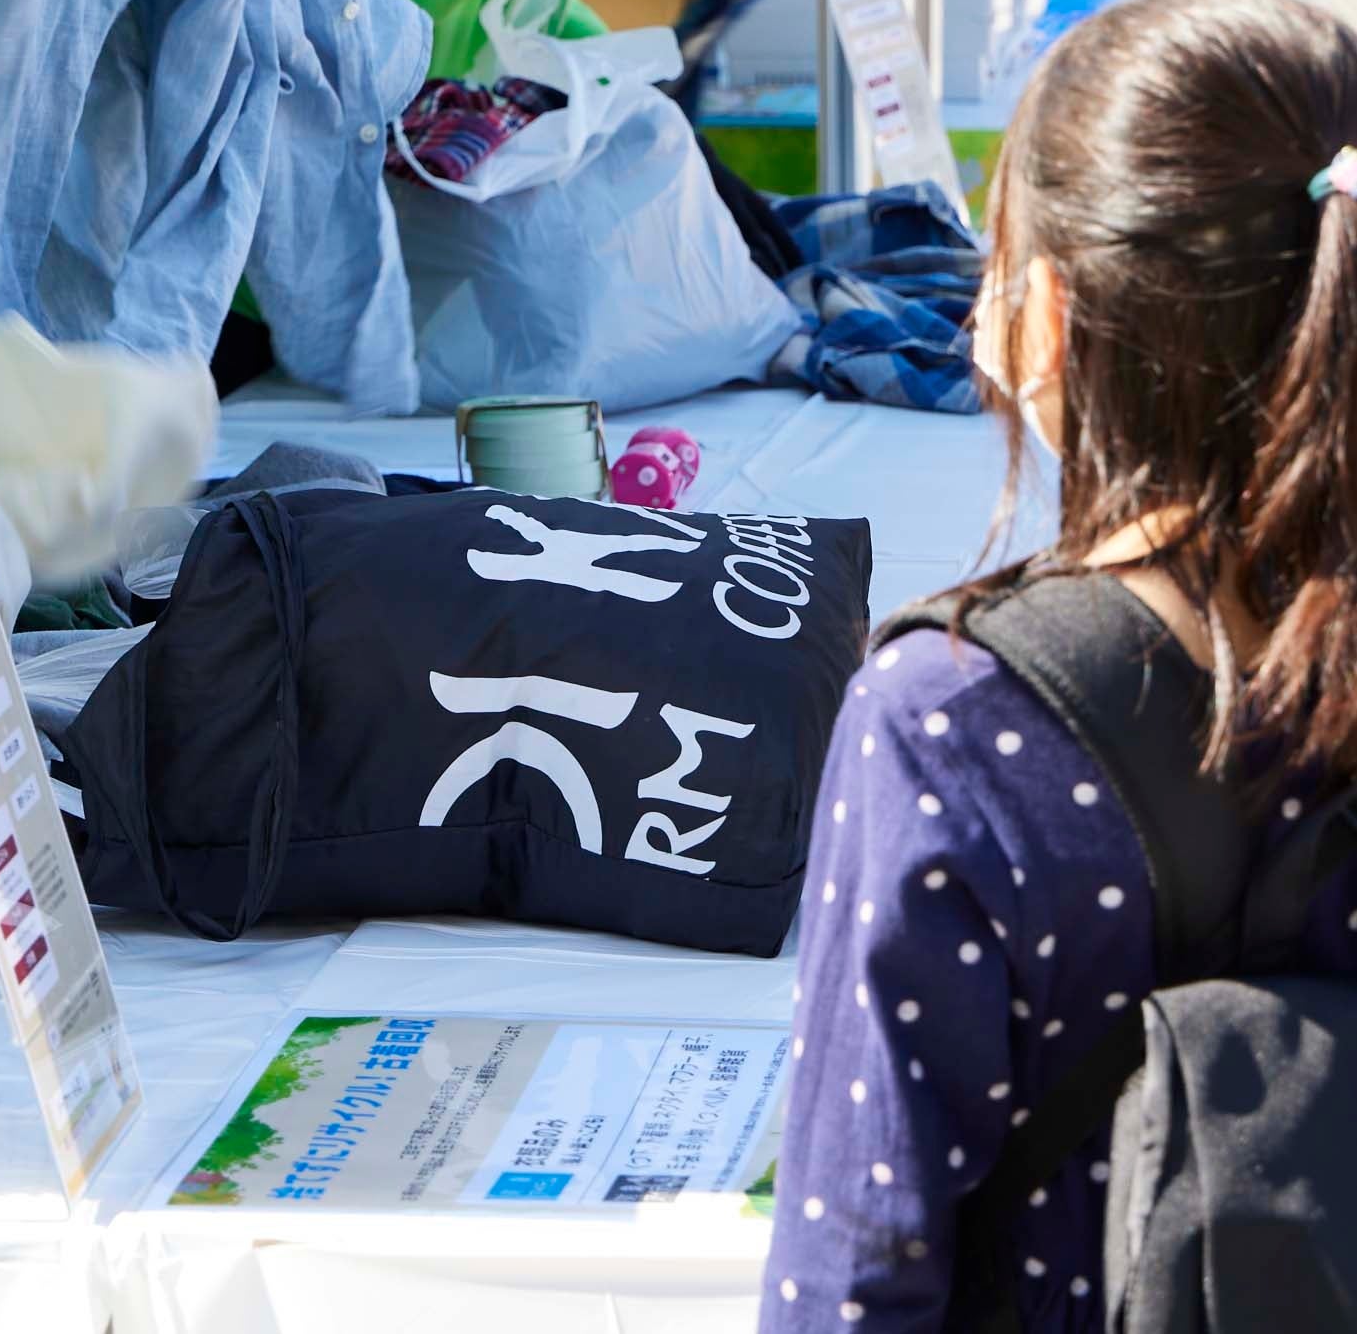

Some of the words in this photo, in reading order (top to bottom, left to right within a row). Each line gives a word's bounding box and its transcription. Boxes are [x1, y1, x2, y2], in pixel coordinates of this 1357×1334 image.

[513, 1118, 569, 1166] 衣類品のみ
